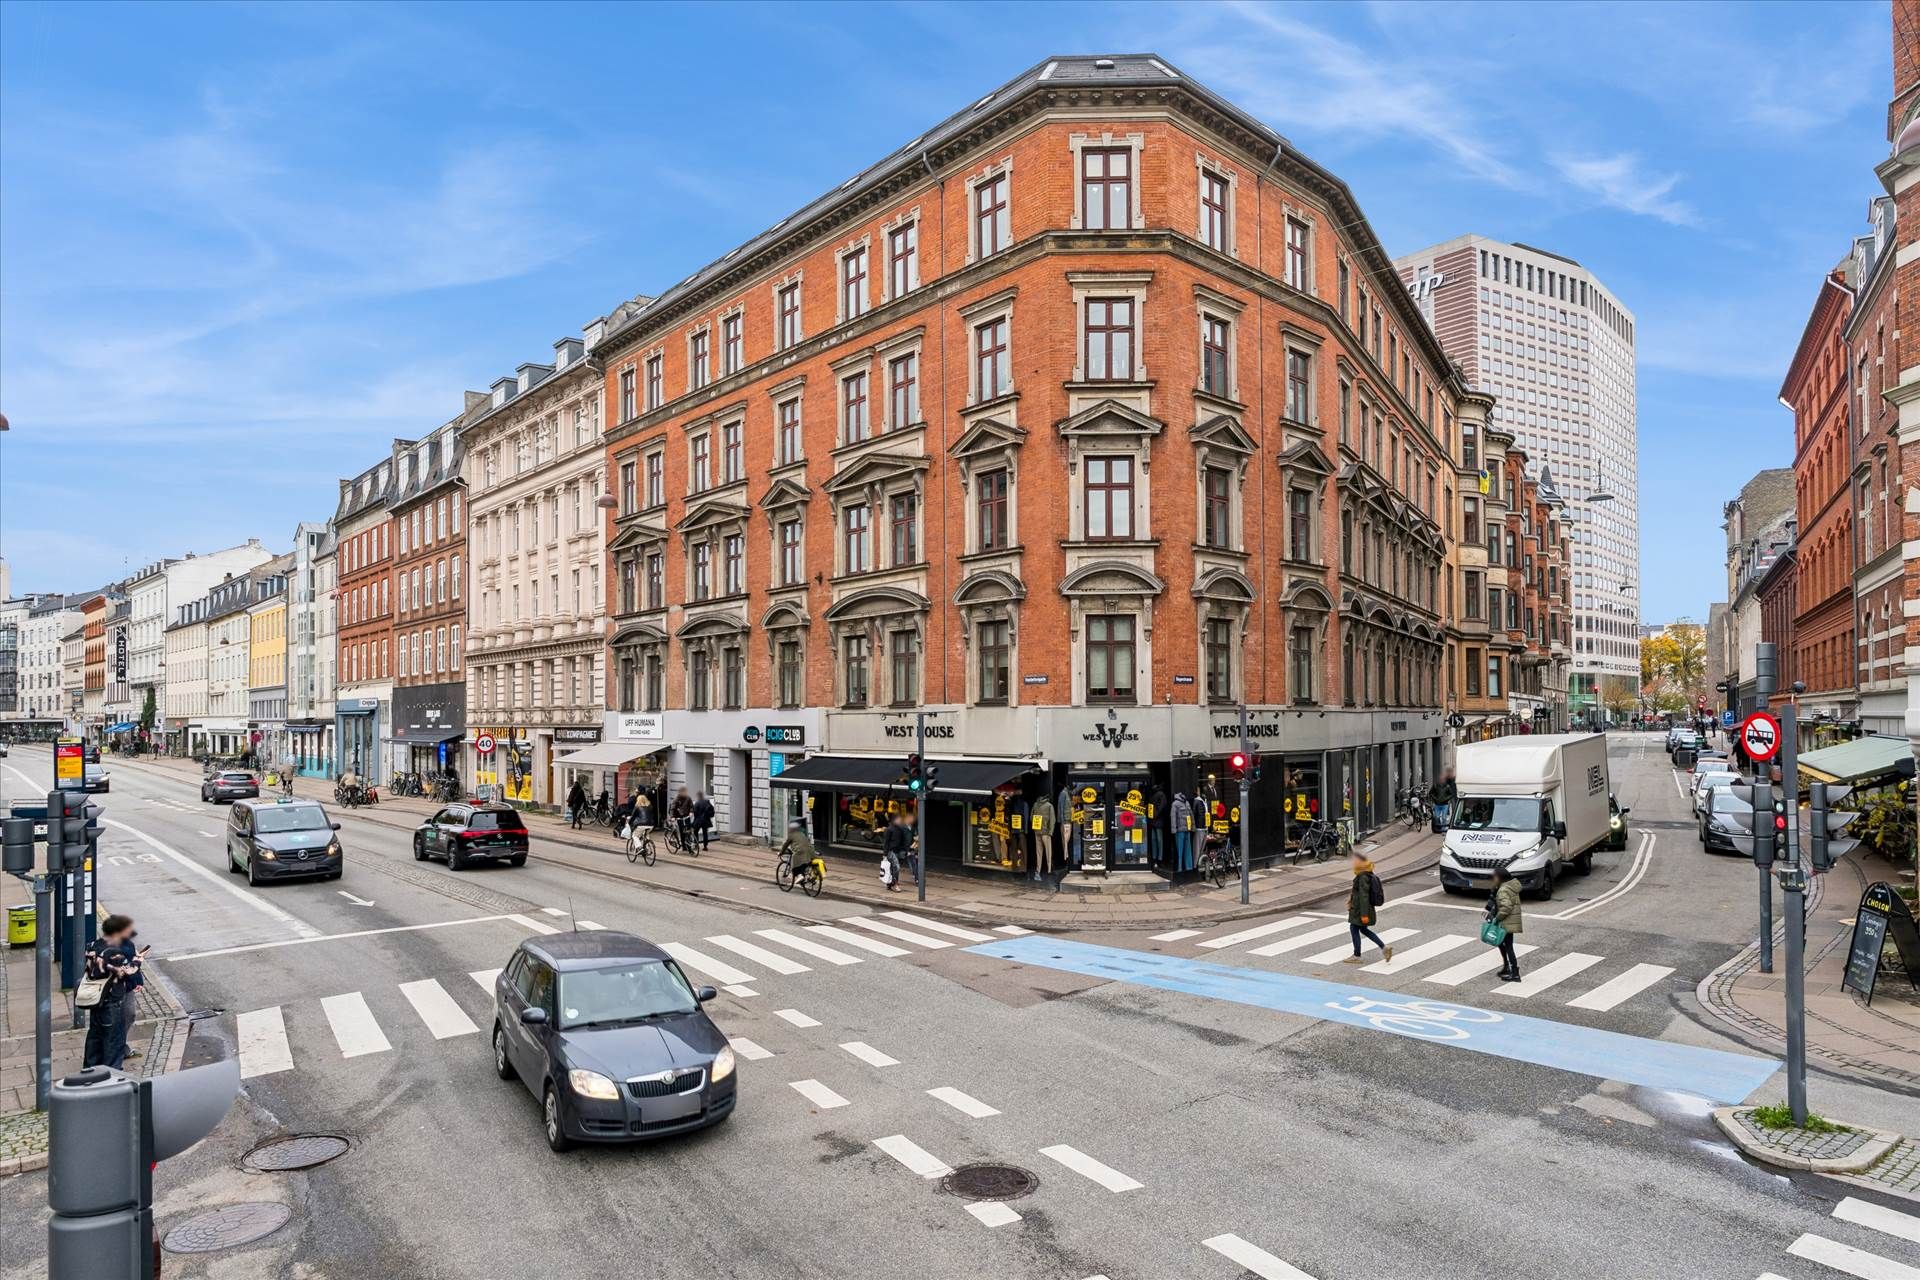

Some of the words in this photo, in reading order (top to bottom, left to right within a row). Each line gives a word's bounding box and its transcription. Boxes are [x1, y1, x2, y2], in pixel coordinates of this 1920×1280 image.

[885, 725, 914, 737] WEST
[916, 726, 954, 738] OUSE
[1246, 724, 1279, 737] HOUSE
[1867, 897, 1889, 912] CHOLON
